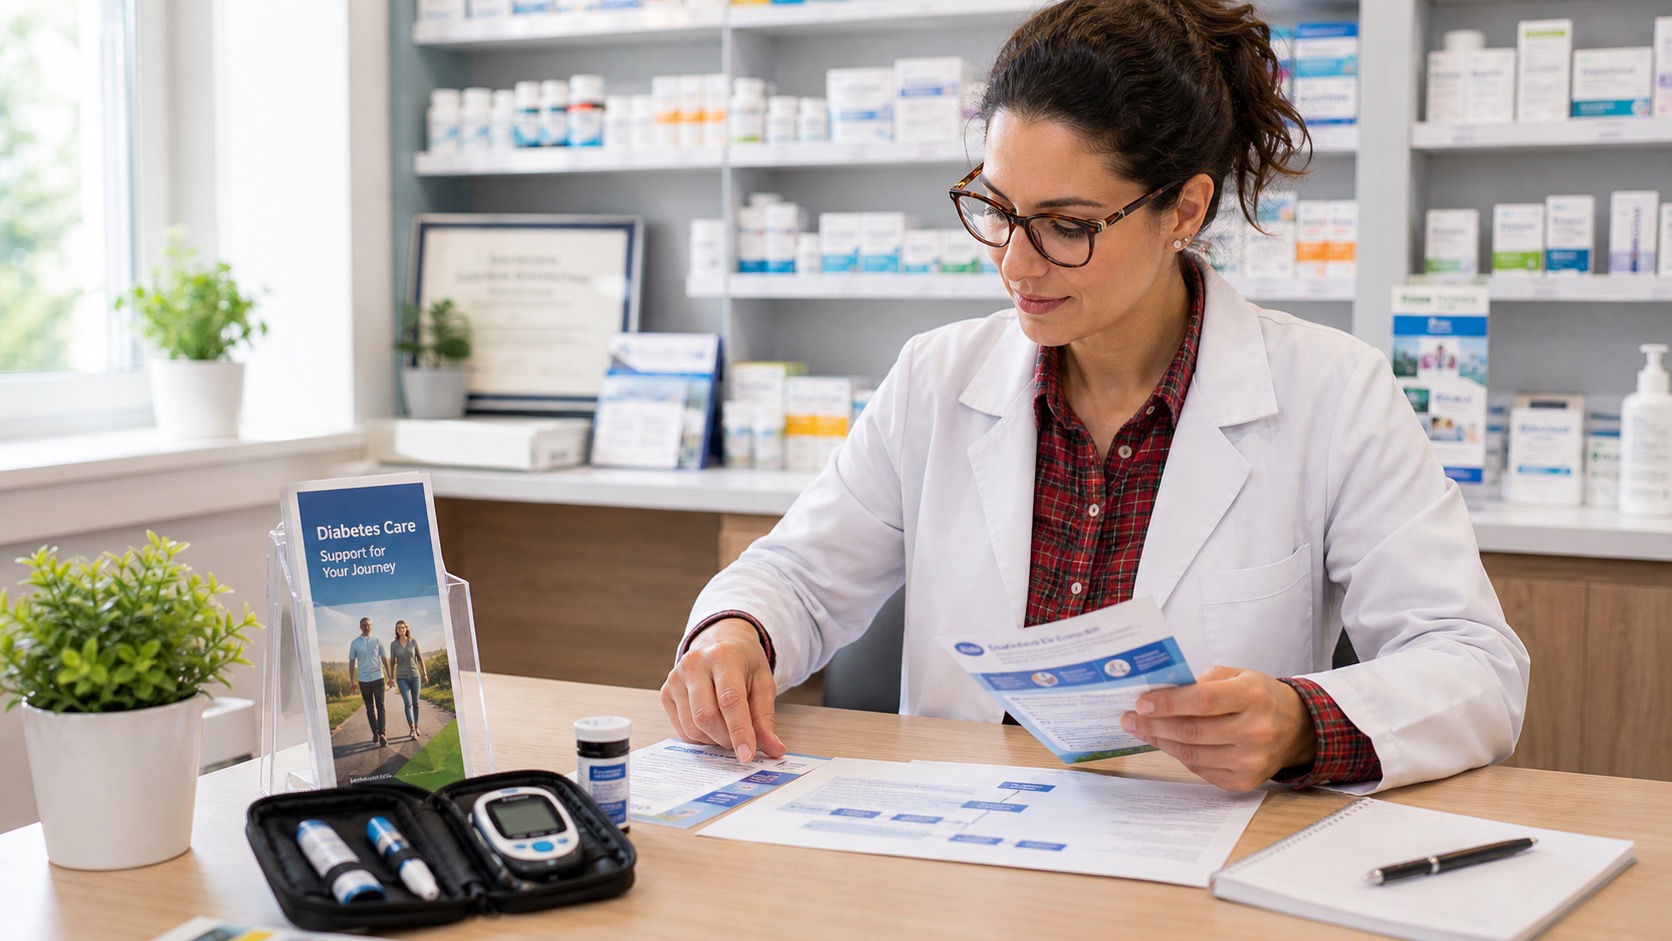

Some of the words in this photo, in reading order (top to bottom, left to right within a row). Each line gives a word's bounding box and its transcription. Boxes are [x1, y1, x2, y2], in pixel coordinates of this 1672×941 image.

[317, 523, 381, 541] Diabetes
[383, 520, 417, 534] Care
[320, 547, 367, 563] Support
[369, 544, 386, 557] for
[322, 567, 348, 578] Your
[351, 562, 396, 576] Journey
